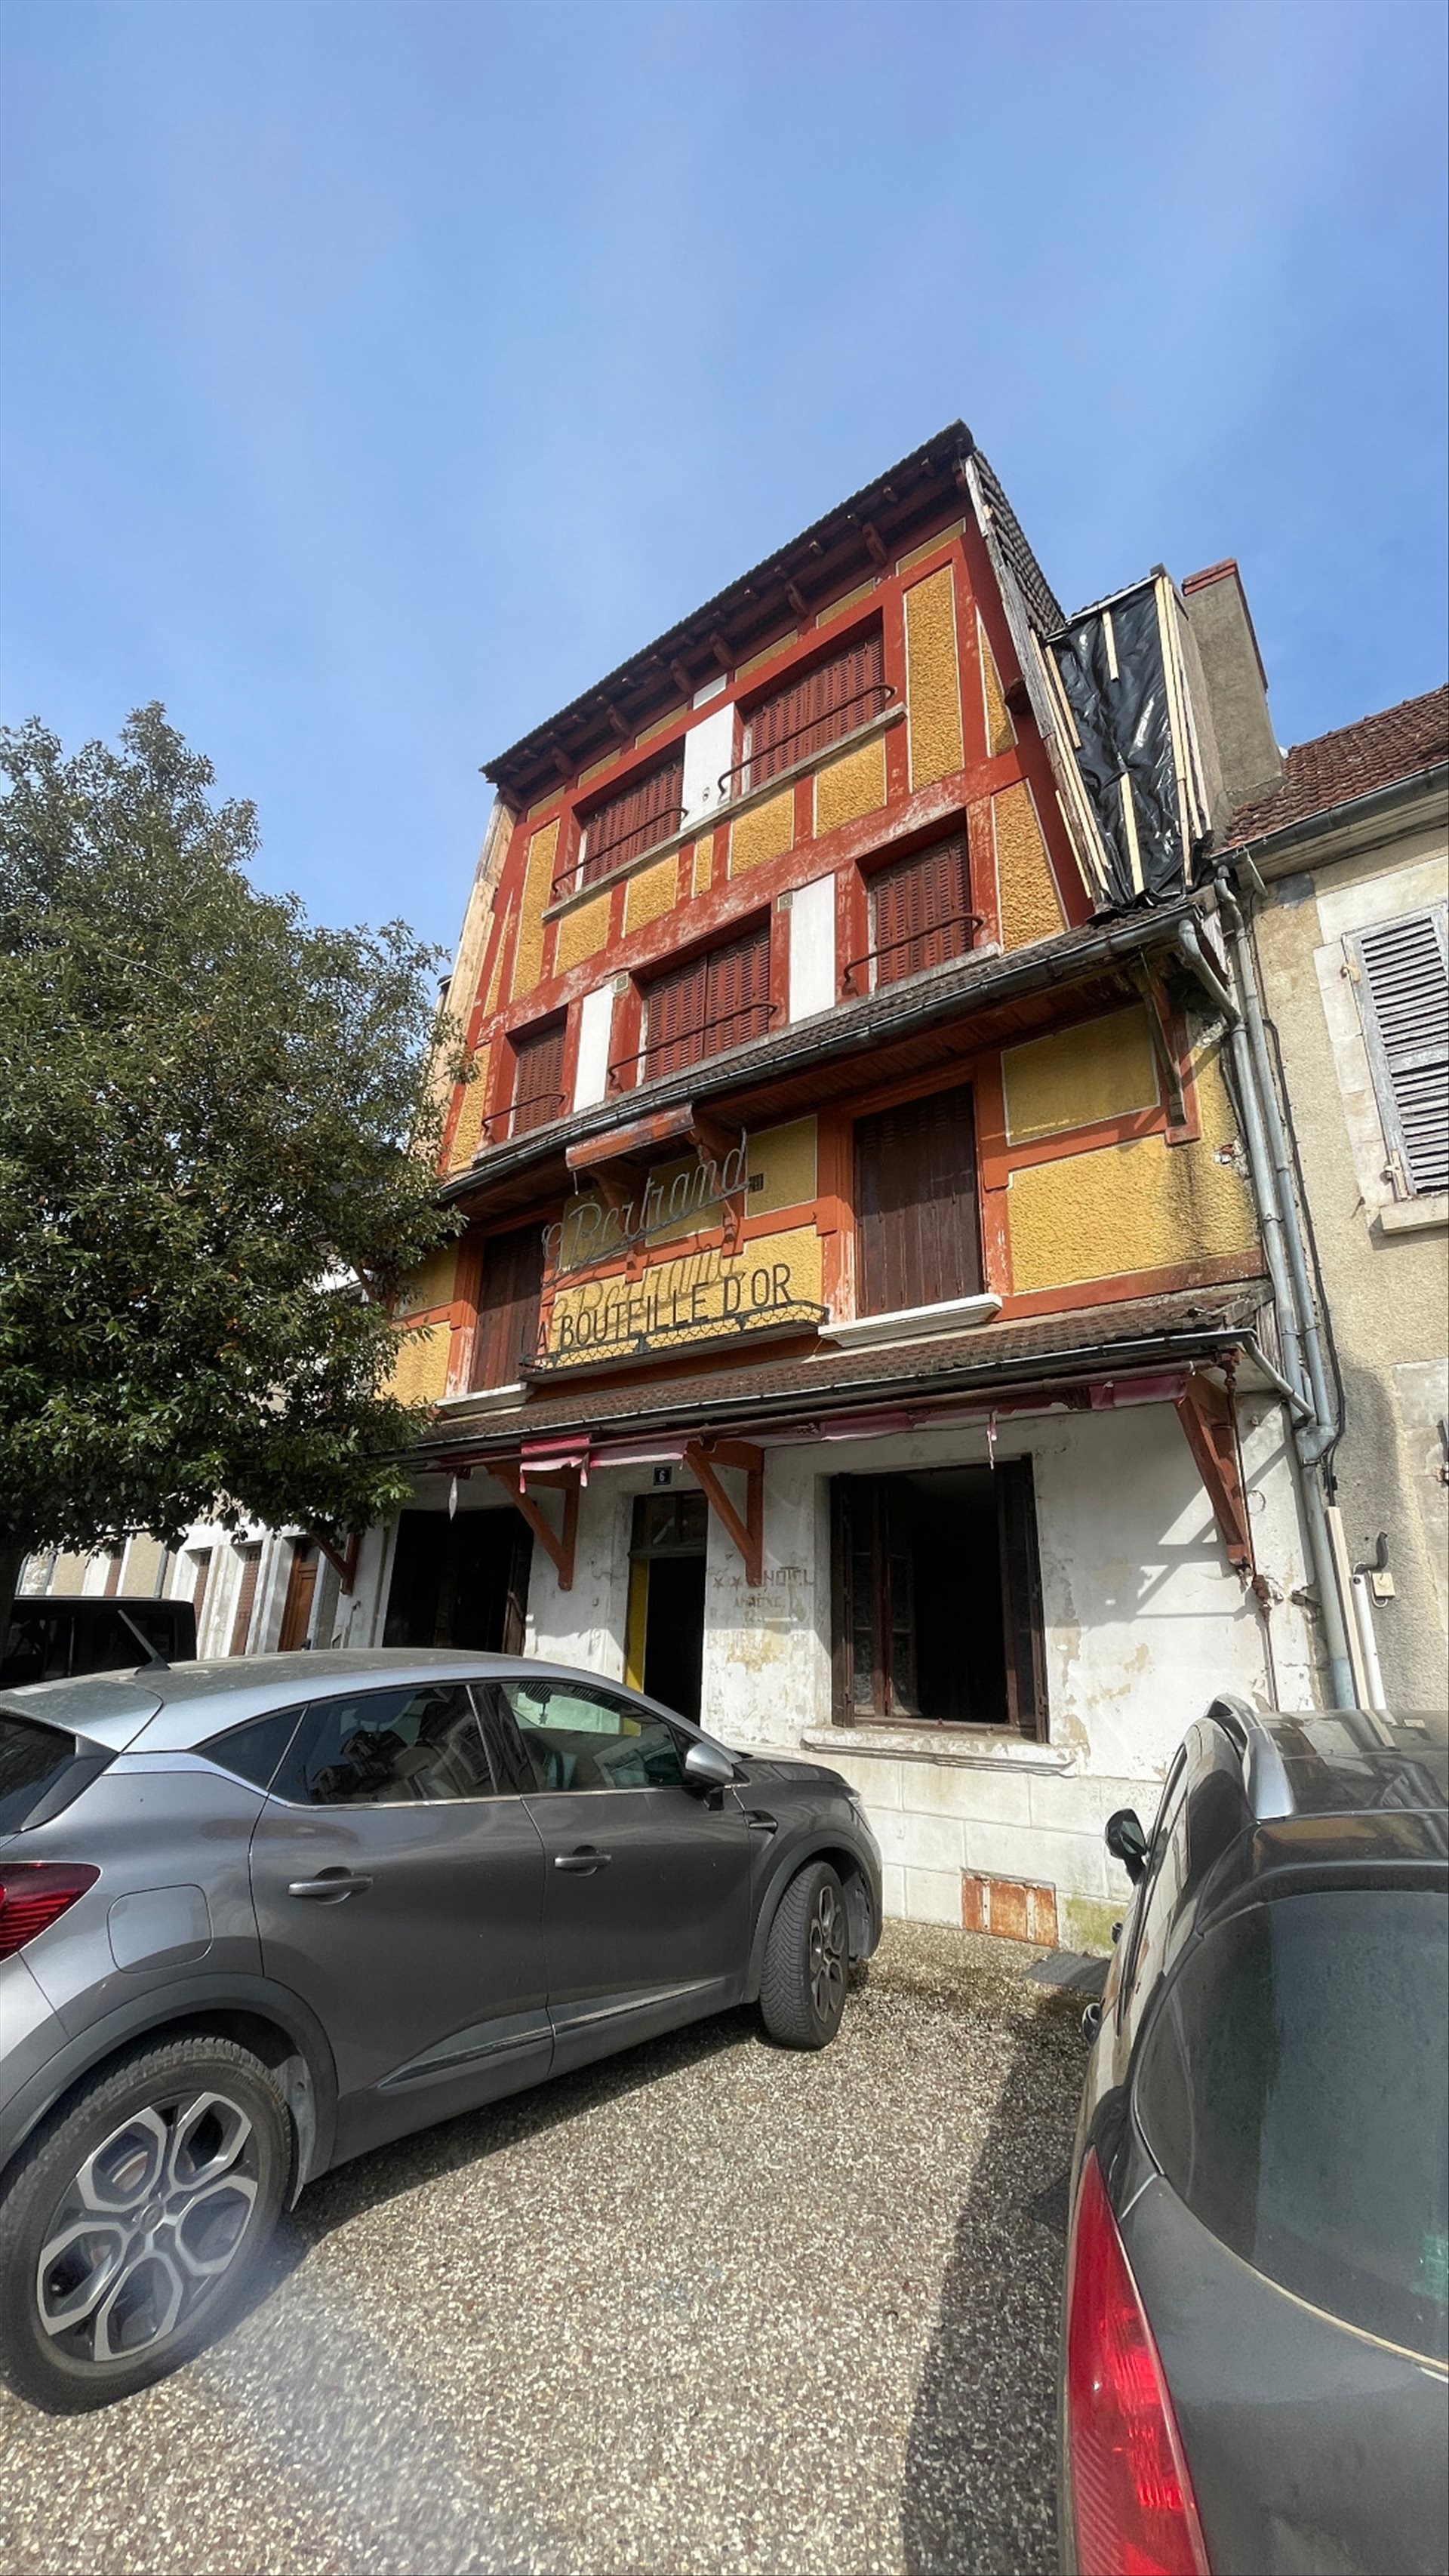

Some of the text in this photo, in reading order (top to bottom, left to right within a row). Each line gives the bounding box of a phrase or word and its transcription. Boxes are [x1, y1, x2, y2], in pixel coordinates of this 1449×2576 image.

[560, 1283, 709, 1349] BOUTEILLE
[723, 1263, 792, 1318] D'OR
[659, 1470, 665, 1482] 6
